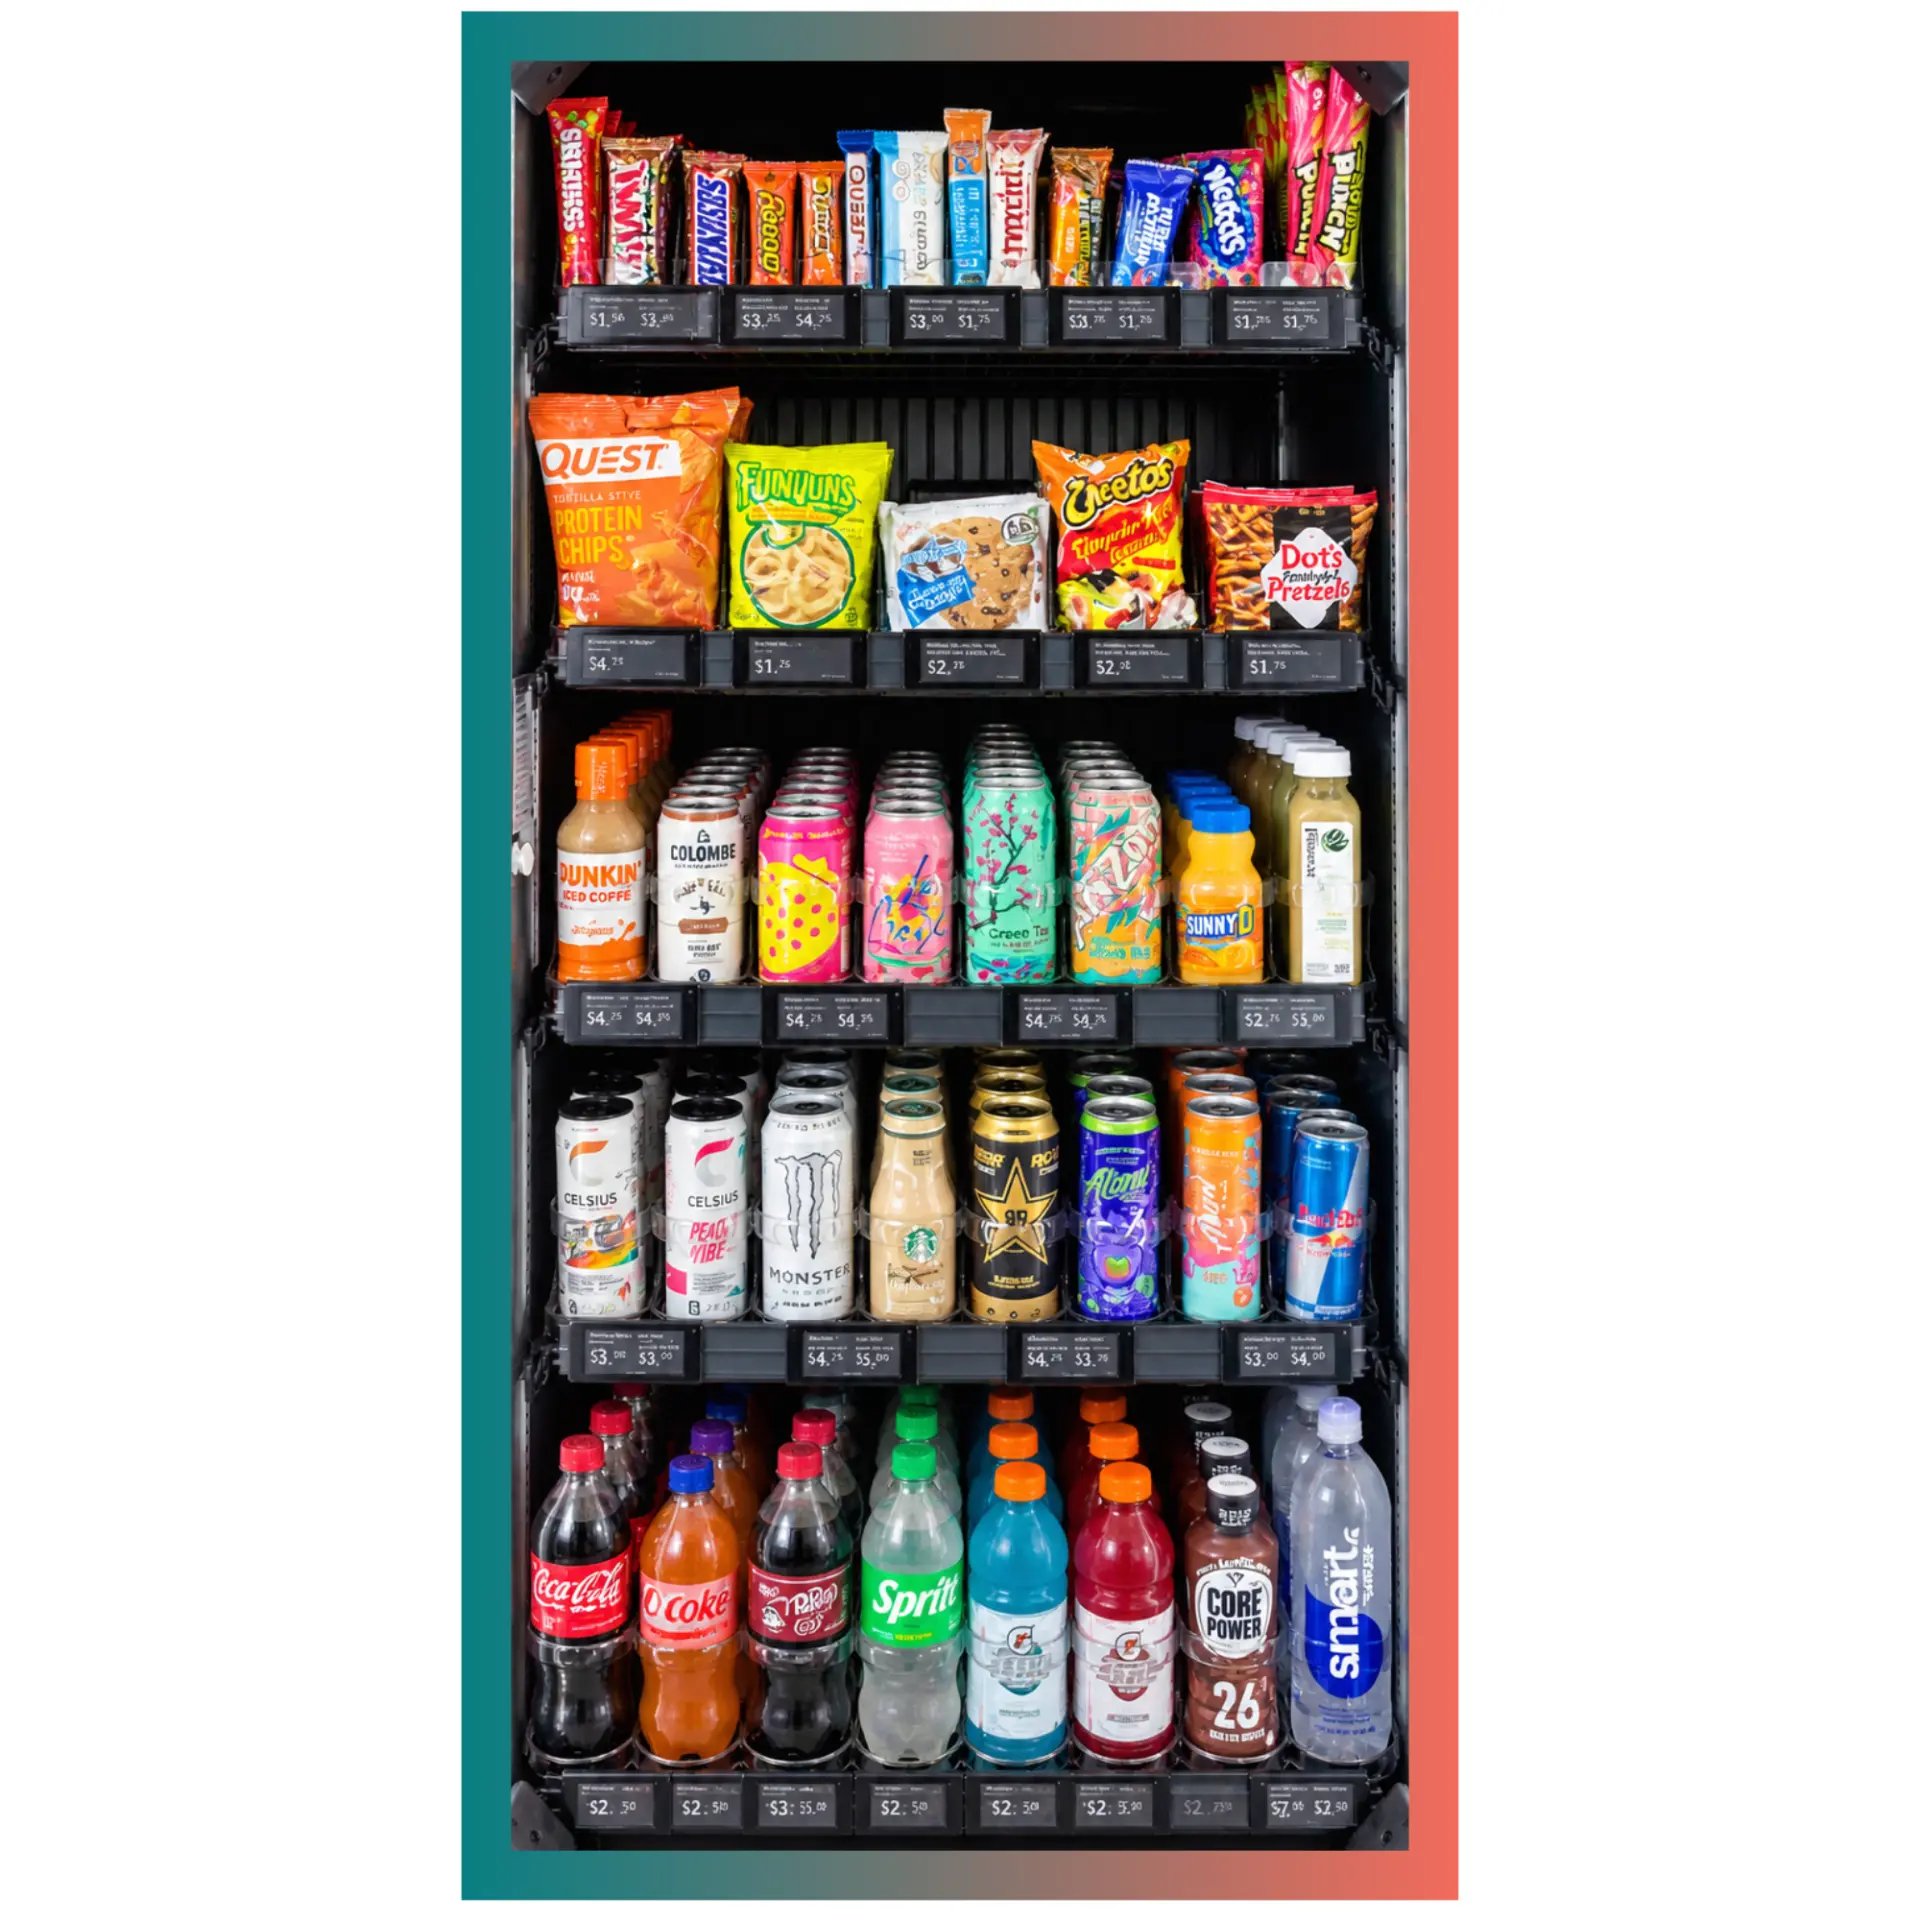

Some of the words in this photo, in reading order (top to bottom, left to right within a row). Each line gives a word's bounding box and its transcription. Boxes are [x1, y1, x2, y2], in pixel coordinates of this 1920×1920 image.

[541, 442, 669, 479] QUEST
[554, 504, 643, 536] PROTEIN
[559, 535, 624, 565] CHIPS
[1281, 543, 1343, 570] Dot's
[670, 842, 736, 862] COLOMBE
[559, 860, 643, 888] DUNKIN'
[564, 1191, 618, 1207] CELSIUS
[687, 1190, 740, 1208] CELSIUS
[769, 1262, 851, 1286] MONSTER
[1207, 1586, 1263, 1619] CORE
[1207, 1616, 1262, 1641] POWER
[1213, 1680, 1261, 1730] 26
